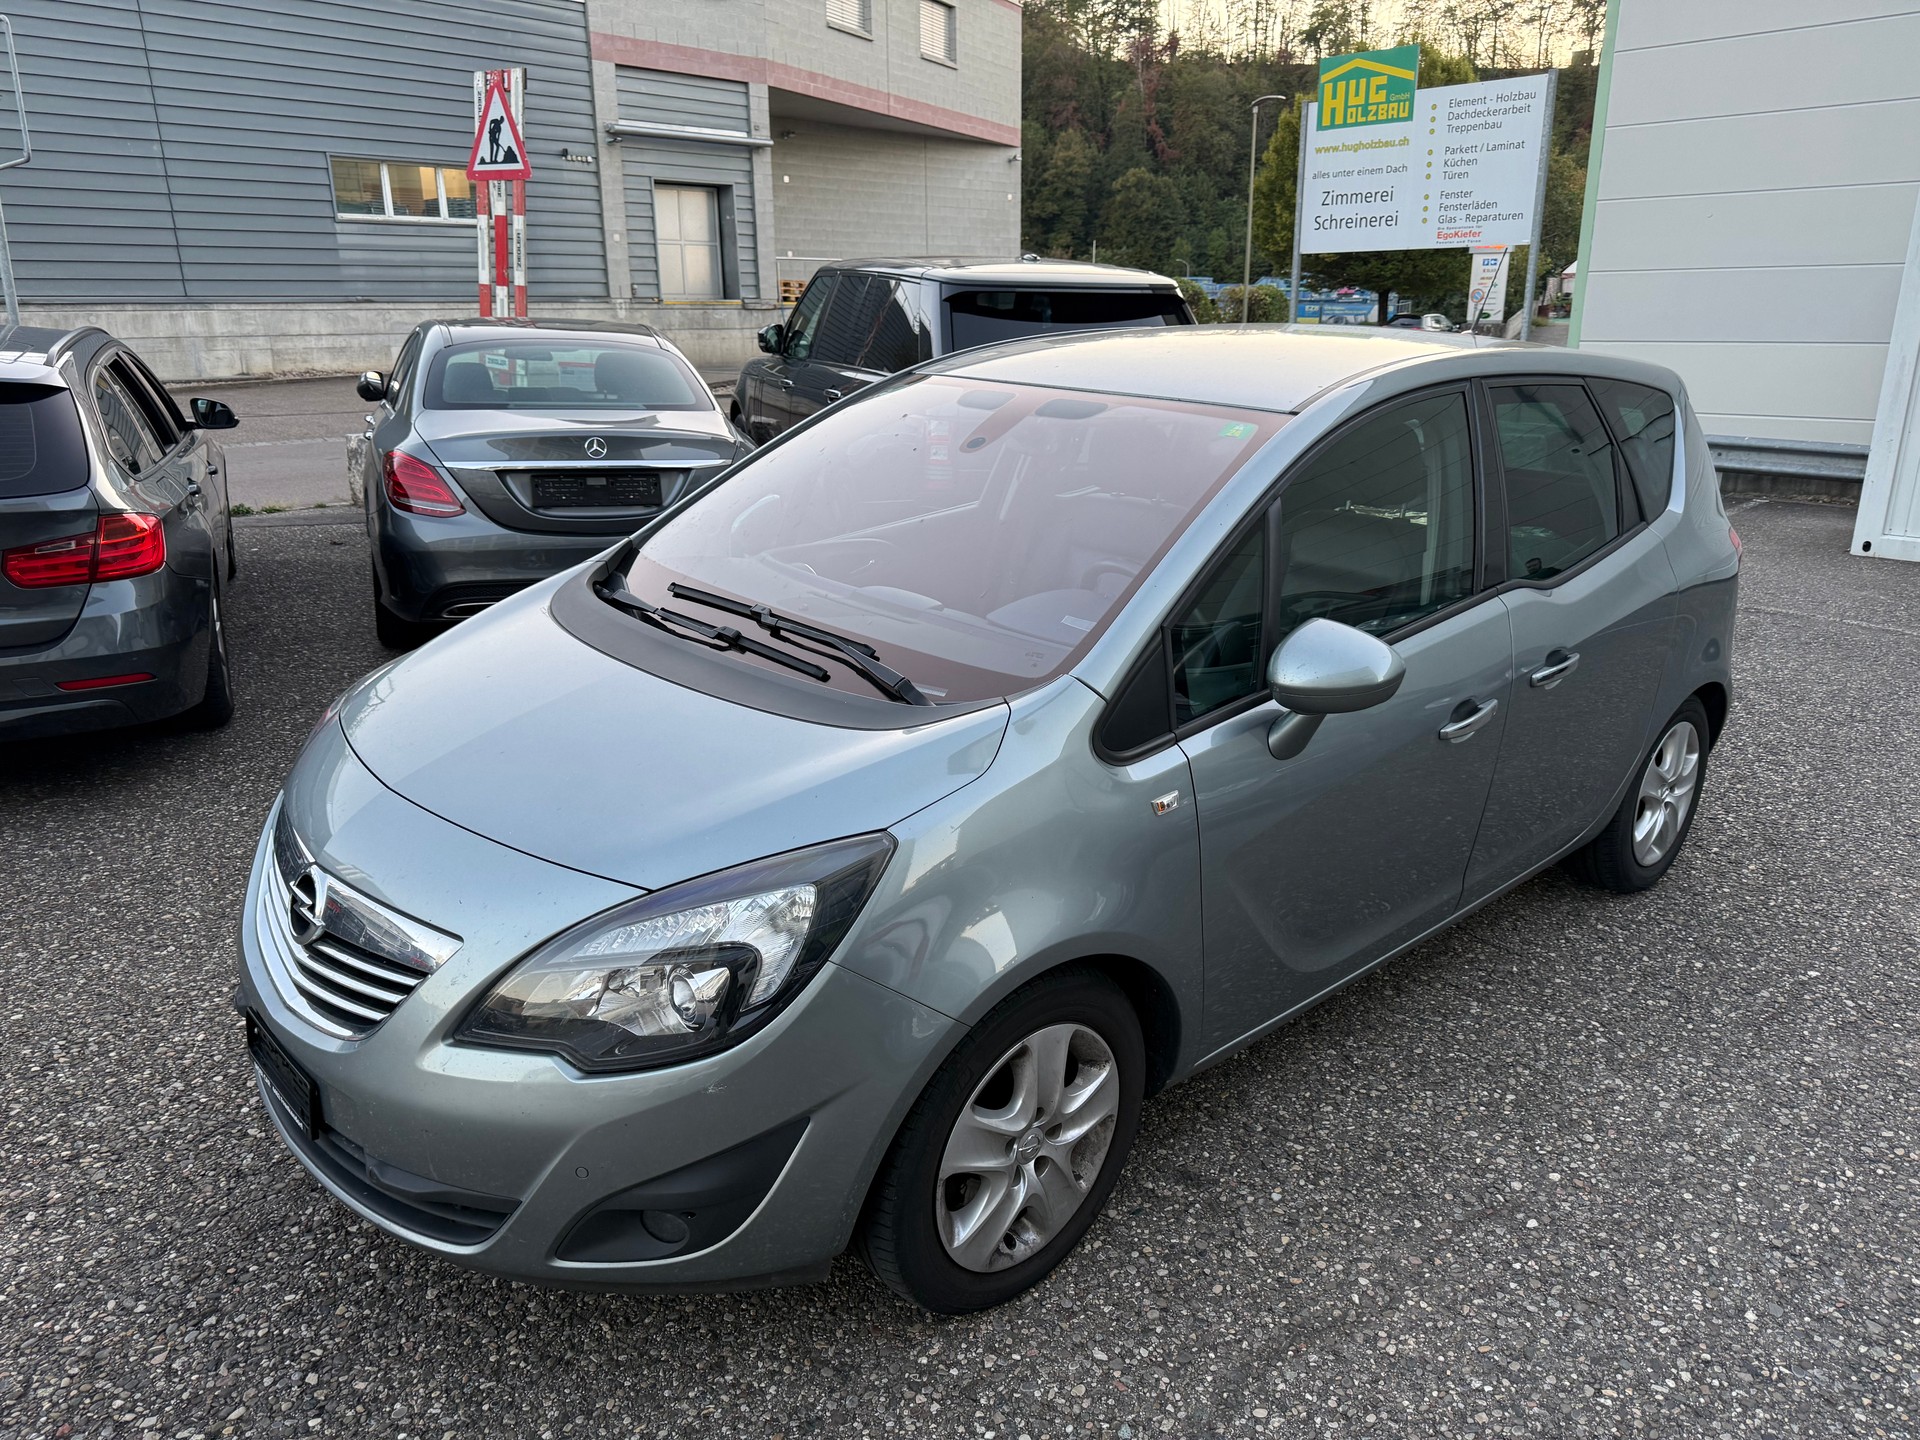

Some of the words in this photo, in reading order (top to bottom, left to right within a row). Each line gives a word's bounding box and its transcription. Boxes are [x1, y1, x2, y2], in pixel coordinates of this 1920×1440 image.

[1389, 92, 1410, 101] GmbH
[1448, 96, 1487, 109] Element
[1496, 91, 1537, 103] Holzbau
[1447, 103, 1531, 121] Dachdeckerarbeit
[1446, 120, 1503, 134] Treppenbau
[1314, 136, 1410, 154] www.hugholzbau.ch
[1444, 144, 1478, 155] Parkett
[1486, 140, 1526, 152] Laminat
[1443, 156, 1478, 168] Küchen
[1312, 170, 1330, 180] alles
[1332, 169, 1355, 178] unter
[1357, 166, 1384, 176] einem
[1385, 163, 1408, 174] Dach
[1442, 170, 1469, 180] Türen
[1321, 185, 1394, 206] Zimmerei
[1439, 190, 1473, 200] Fenster
[1438, 200, 1498, 212] Fensterläden
[1313, 210, 1399, 231] Schreinerei
[1437, 214, 1457, 224] Glas
[1464, 212, 1524, 224] Reparaturen
[1436, 229, 1482, 240] EgoKiefer
